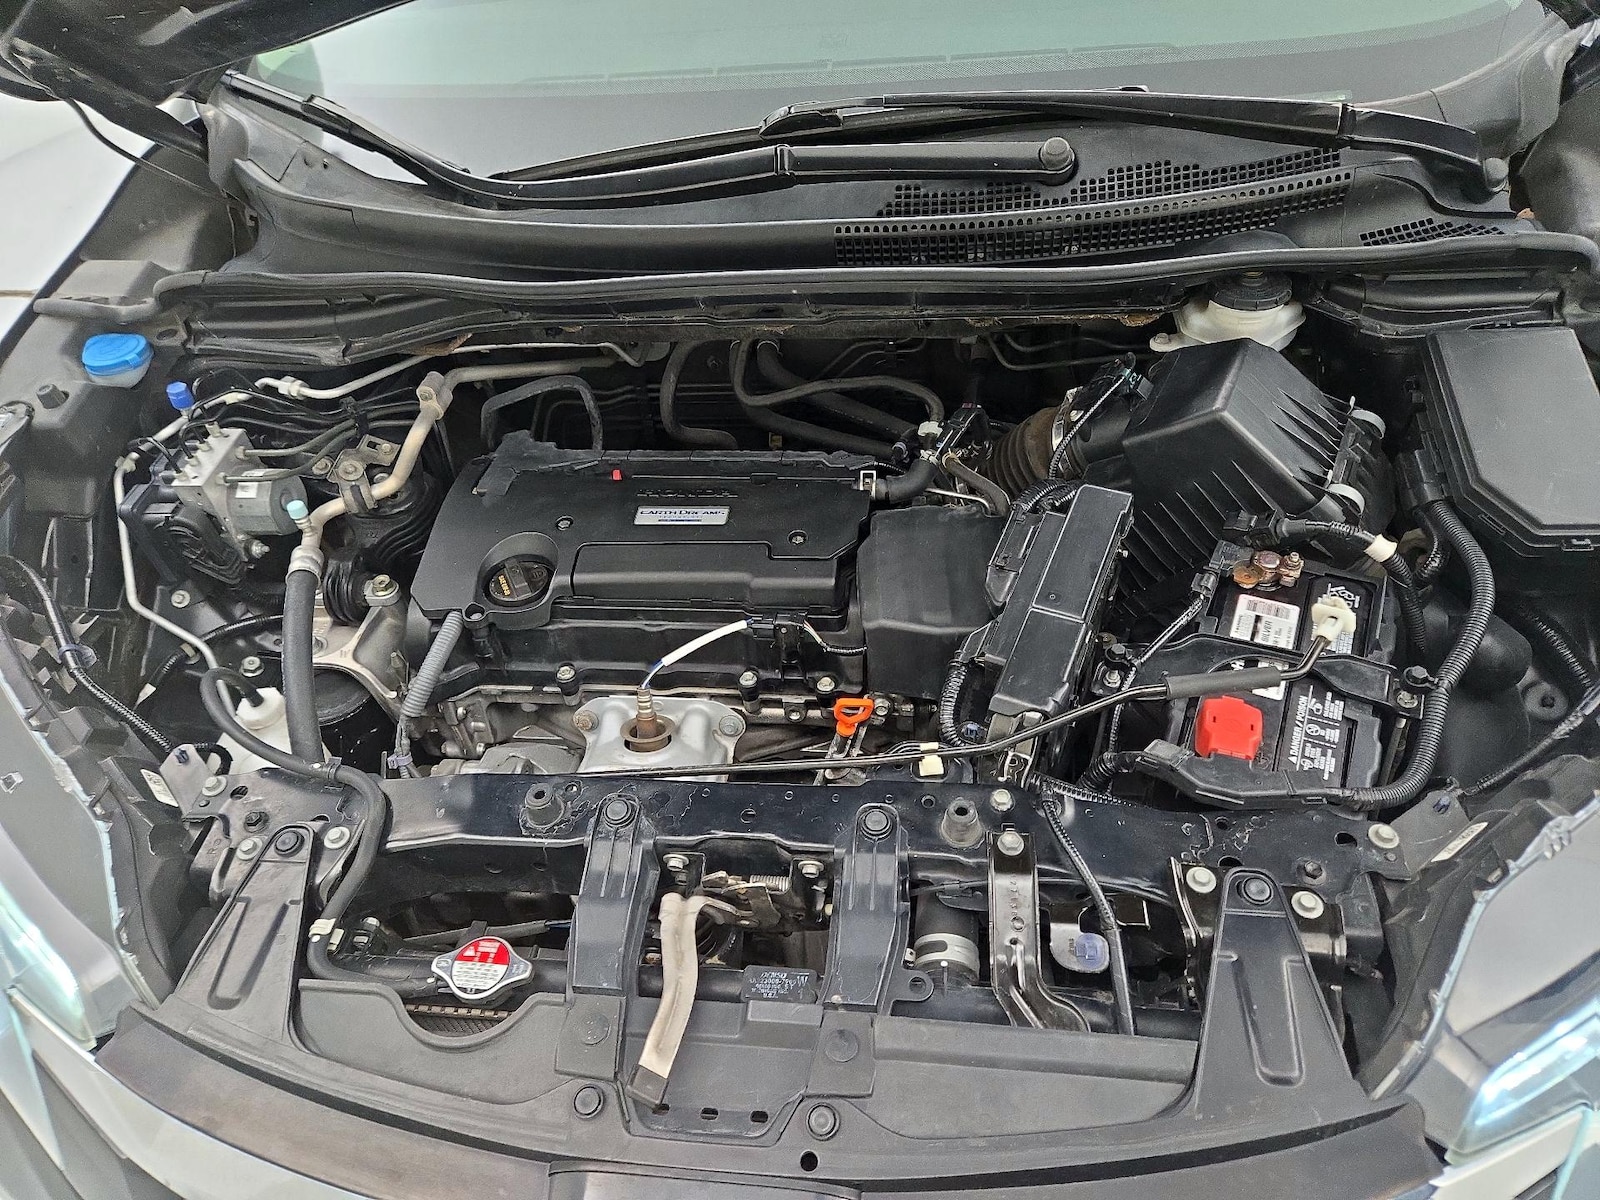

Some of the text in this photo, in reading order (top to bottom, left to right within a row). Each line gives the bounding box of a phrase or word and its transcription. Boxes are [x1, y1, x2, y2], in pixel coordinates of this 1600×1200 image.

[1261, 620, 1272, 643] SILVER
[1289, 727, 1303, 756] DANGER
[1296, 695, 1308, 721] POISON
